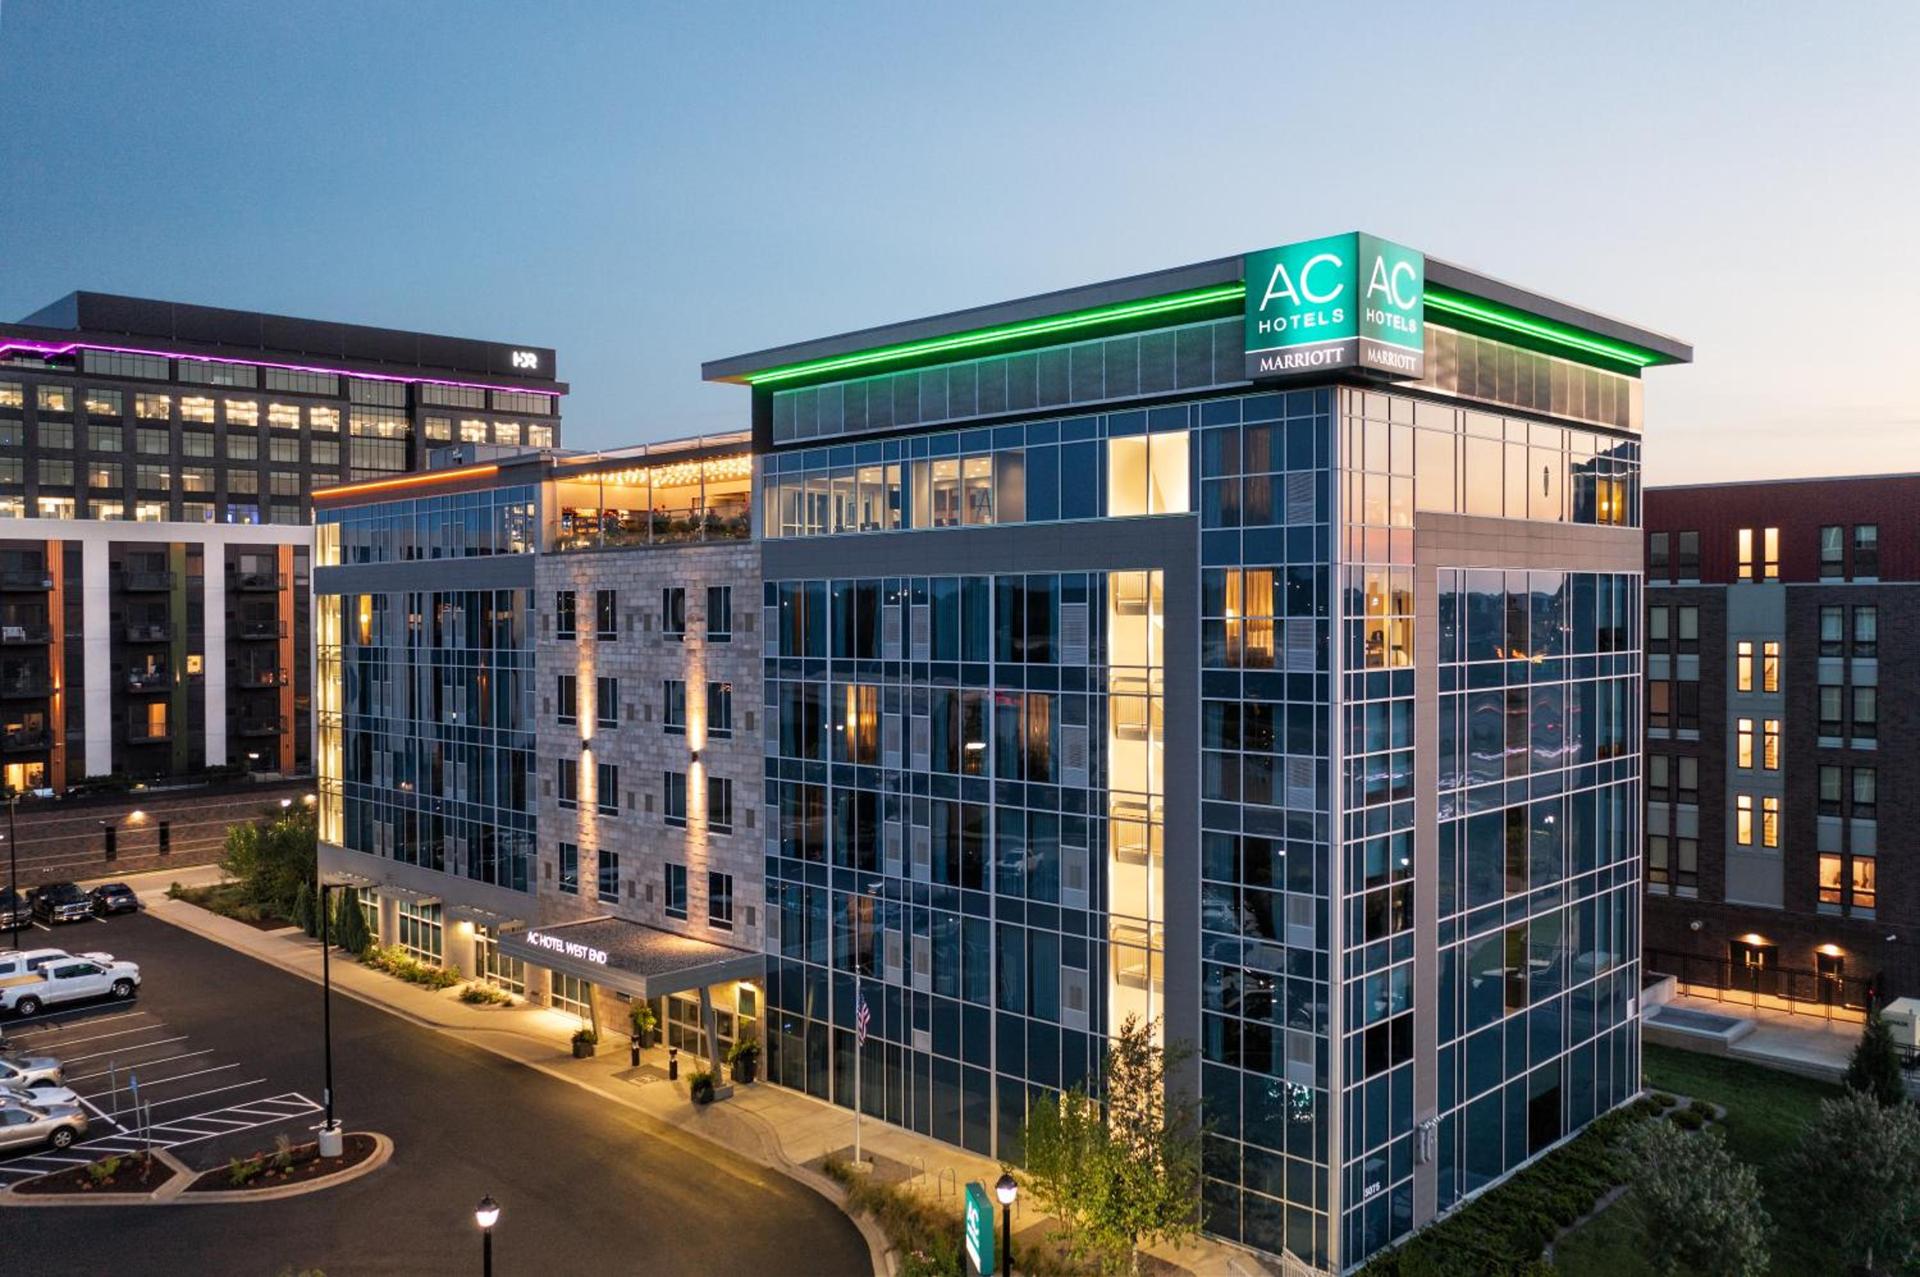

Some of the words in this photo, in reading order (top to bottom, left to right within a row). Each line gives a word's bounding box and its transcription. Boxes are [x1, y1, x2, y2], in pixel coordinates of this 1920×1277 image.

[1259, 253, 1344, 311] AC
[1367, 255, 1417, 310] AC
[1258, 308, 1345, 334] HOTELS
[1366, 308, 1417, 334] HOTELS
[1260, 347, 1345, 372] MARRIOTT
[1367, 348, 1416, 371] MARRIOTT
[526, 931, 539, 946] AC
[539, 934, 565, 953] HOTEL
[565, 941, 588, 960] WEST
[588, 948, 608, 965] END
